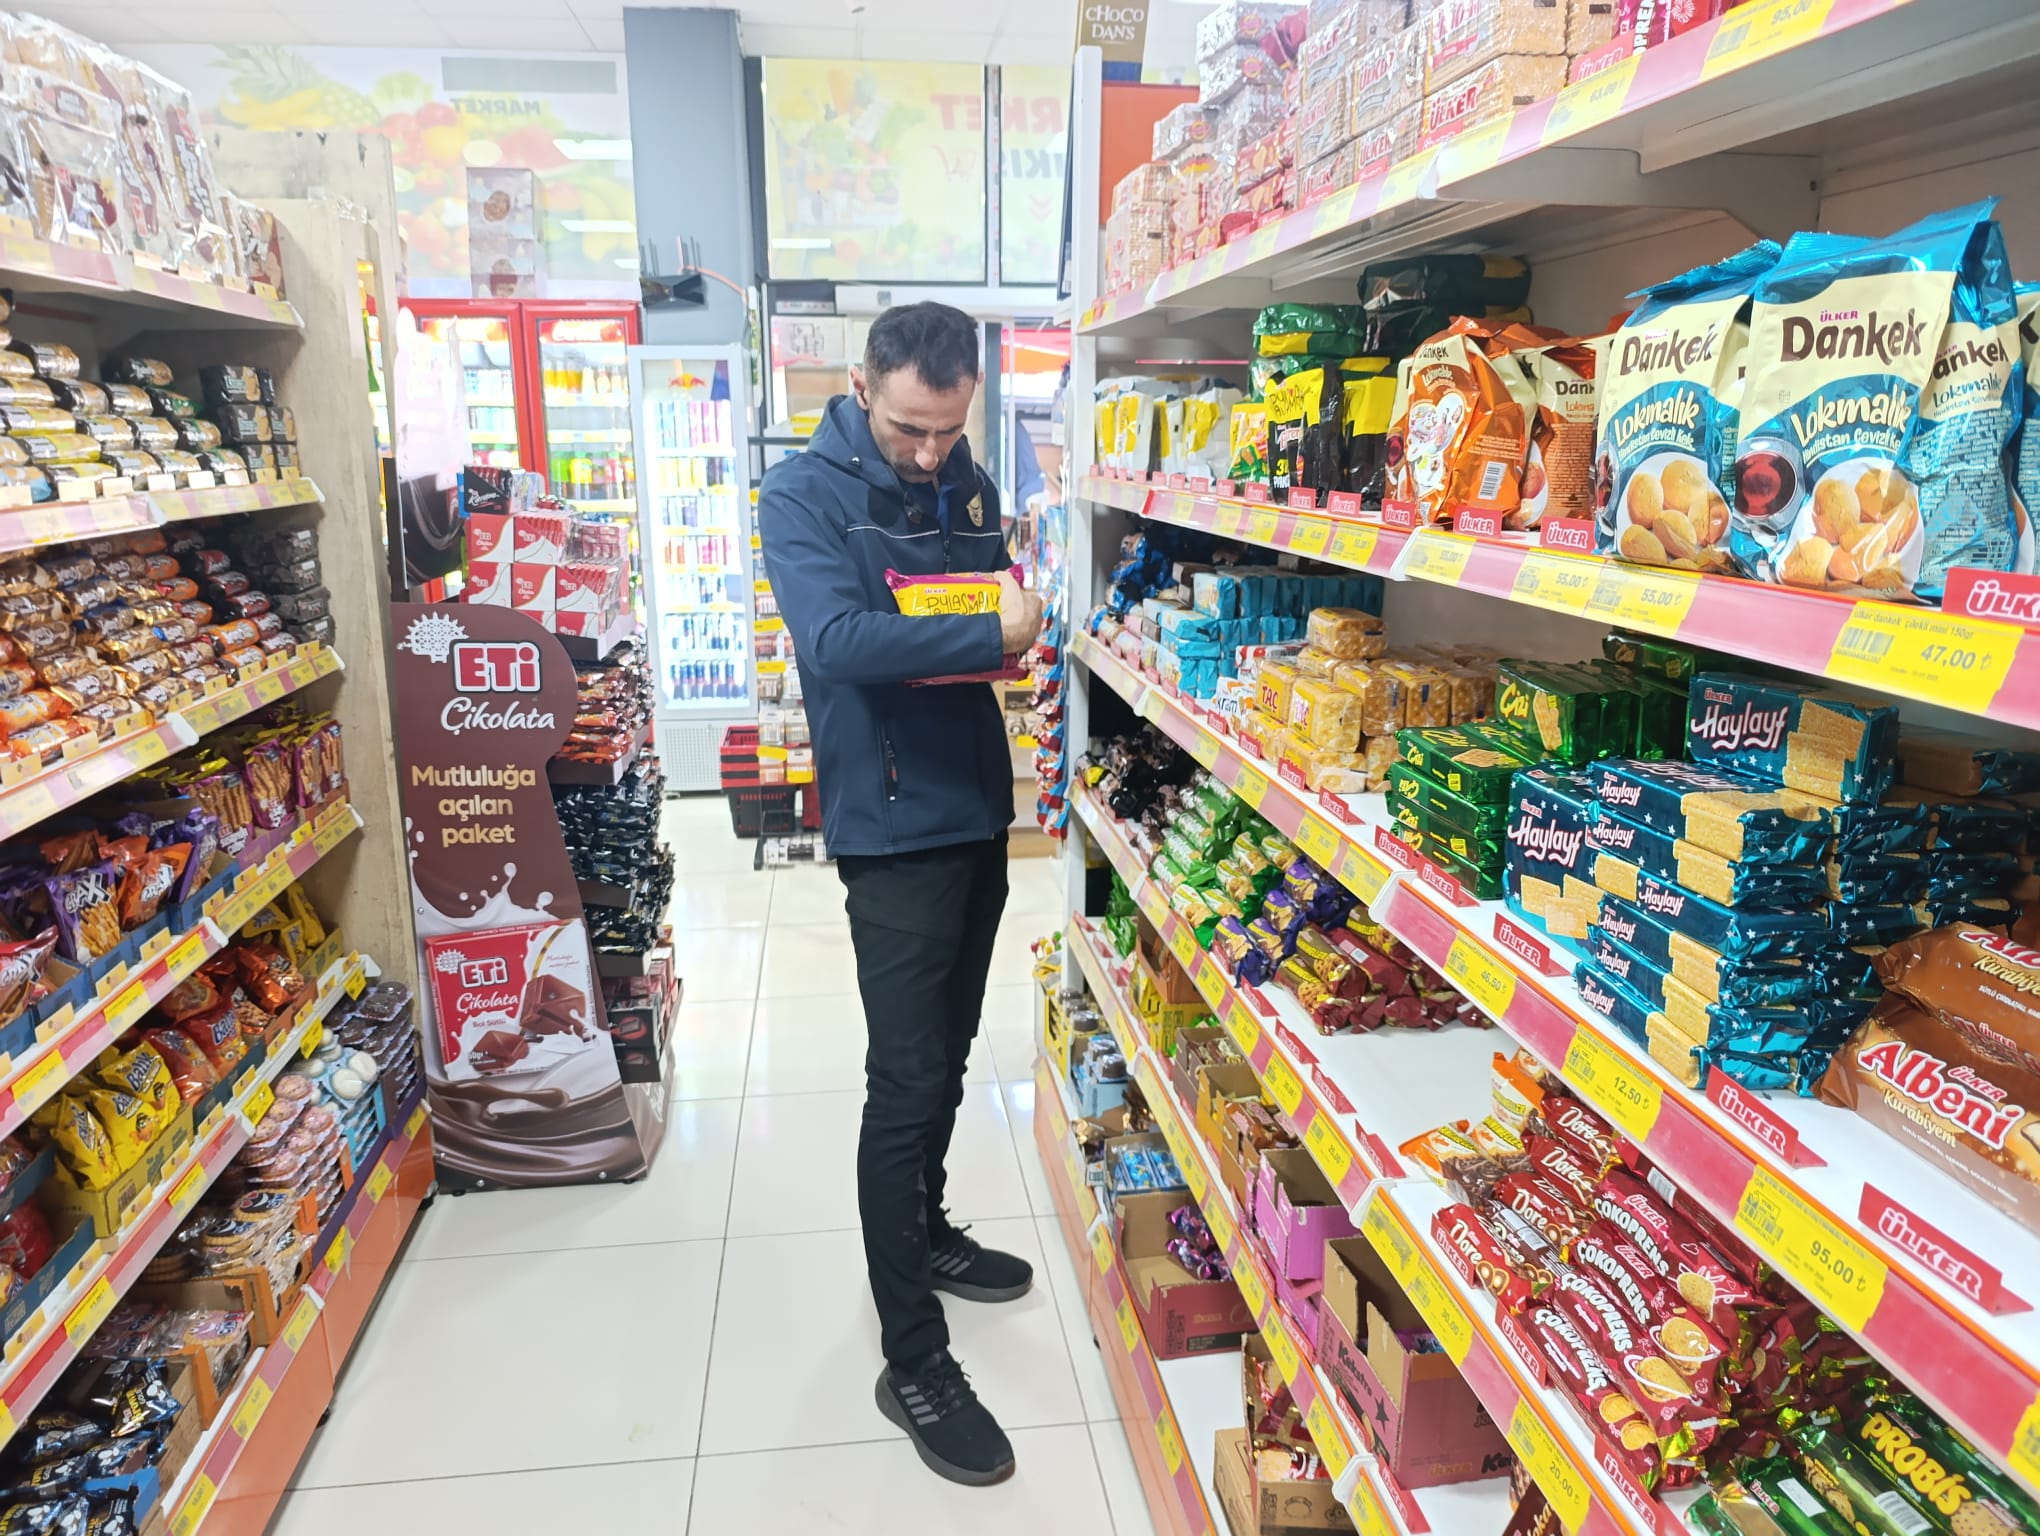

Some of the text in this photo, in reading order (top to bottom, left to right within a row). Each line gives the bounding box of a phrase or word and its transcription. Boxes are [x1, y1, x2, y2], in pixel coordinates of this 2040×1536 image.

[1086, 5, 1145, 24] CHOCO
[1429, 86, 1478, 131] ÜLKER
[1820, 309, 1859, 323] ÜLKER
[1620, 323, 1719, 376] Dankek
[1780, 308, 1928, 366] Dankek
[1384, 504, 1410, 525] ÜLKER
[1459, 511, 1495, 535] ÜLKER
[1546, 521, 1589, 549] ÜLKER
[1641, 587, 1674, 606] 55,00
[1966, 579, 2040, 622] ÜLK
[1920, 643, 1977, 670] 47,00
[1704, 687, 1733, 704] ÜLKER
[440, 696, 556, 736] Çikolata
[1690, 701, 1788, 751] Haylayf
[411, 764, 537, 790] Mutluluğa
[1597, 779, 1642, 806] Haylayf
[437, 795, 514, 822] açılan
[1321, 790, 1346, 821] ÜLKER
[441, 823, 516, 848] paket
[1378, 833, 1409, 867] ÜLKER
[1507, 815, 1583, 868] Haylayf
[1593, 820, 1635, 849] Haylayf
[64, 871, 112, 914] CRAX
[1422, 862, 1455, 900] ÜLKER
[1638, 885, 1685, 917] Haylayf
[1498, 922, 1542, 968] ÜLKER
[1599, 911, 1636, 943] Haylayf
[1596, 947, 1631, 979] Haylayf
[456, 991, 520, 1015] Çikolata
[1578, 982, 1616, 1016] Haylayf
[1979, 1021, 2017, 1050] ÜLKER
[1857, 1040, 2026, 1150] Albeni
[1948, 1065, 2008, 1102] ÜLKER
[1557, 1106, 1600, 1140] Dore
[1718, 1084, 1786, 1156] ÜLKER
[1883, 1088, 1957, 1148] Kurabiyem
[1541, 1146, 1583, 1181] Dore
[1512, 1188, 1548, 1230] Dore
[1629, 1194, 1668, 1230] ÜLKER
[1436, 1229, 1470, 1282] ÜLKER
[1449, 1218, 1483, 1264] Dore
[1877, 1205, 1984, 1302] ÜLKER
[1615, 1243, 1655, 1280] ÜLKER
[1501, 1314, 1540, 1380] ÜLKER
[1549, 1462, 1574, 1498] 20,00
[1603, 1452, 1657, 1534] ÜLKER
[1749, 1478, 1781, 1517] ÜLKER
